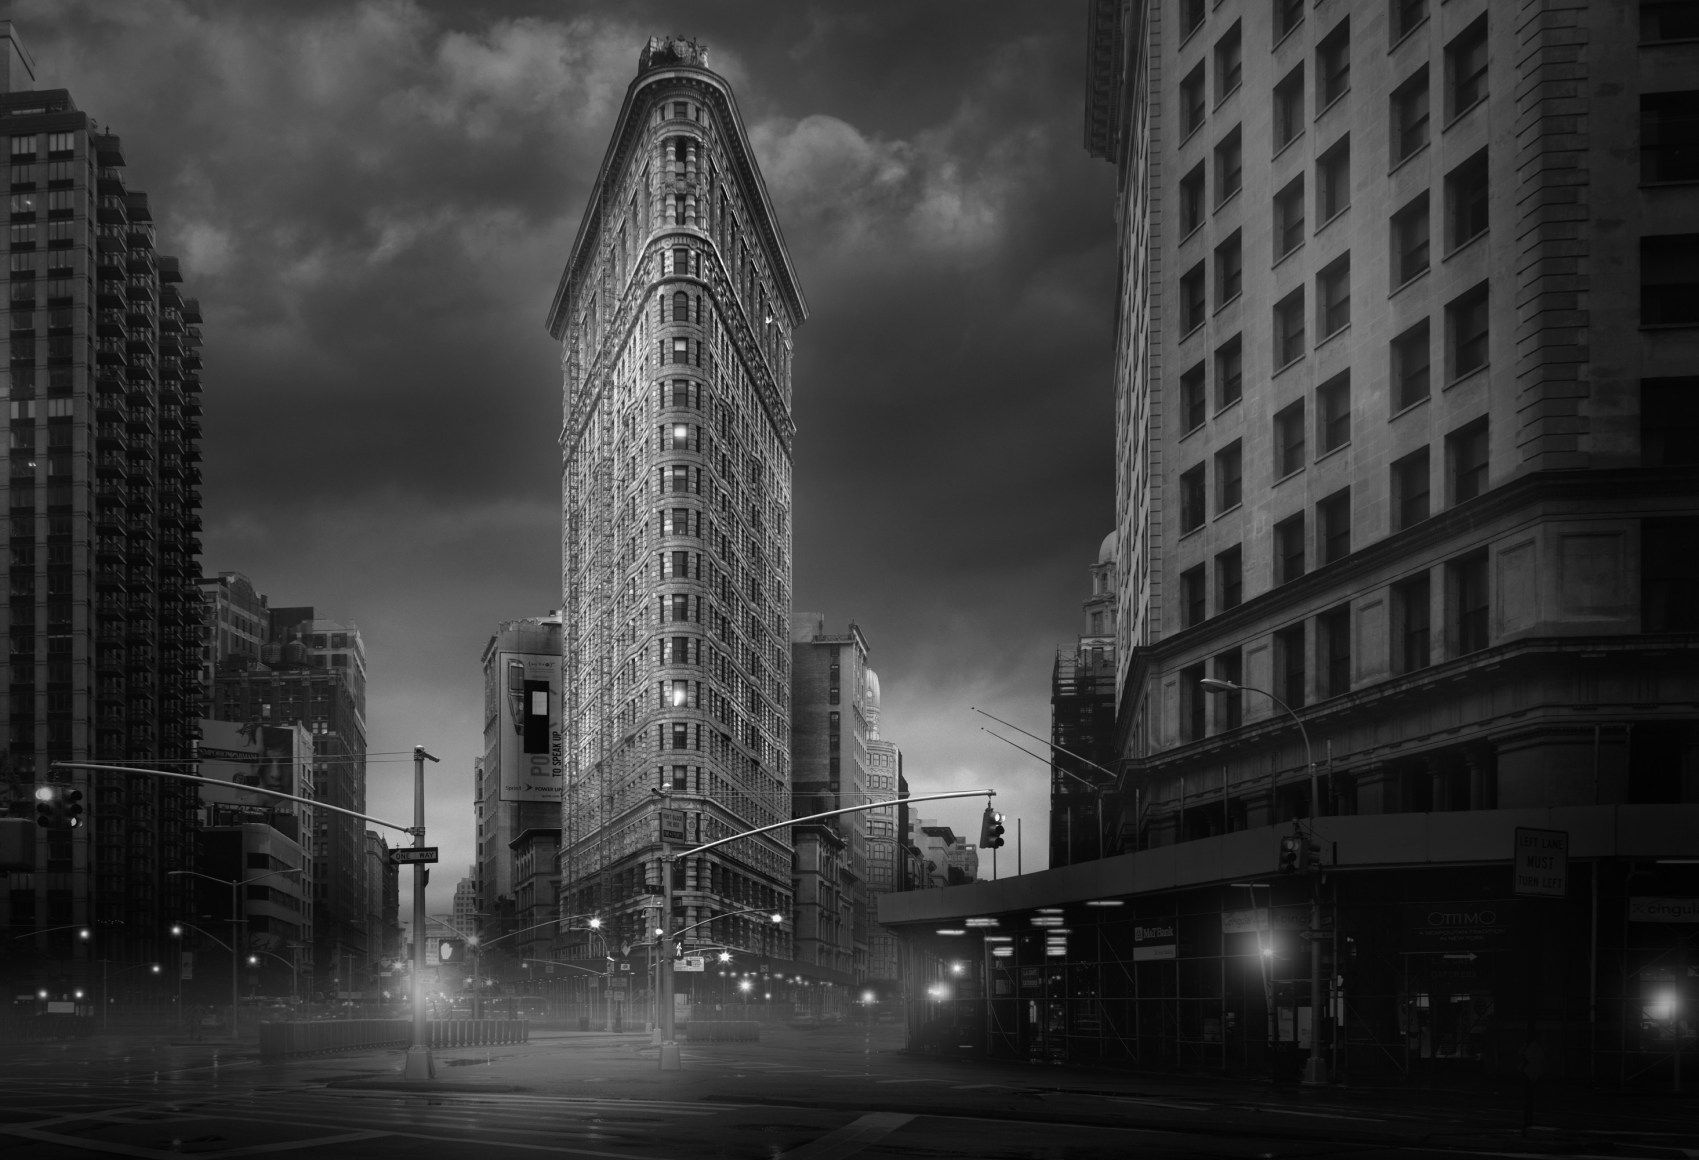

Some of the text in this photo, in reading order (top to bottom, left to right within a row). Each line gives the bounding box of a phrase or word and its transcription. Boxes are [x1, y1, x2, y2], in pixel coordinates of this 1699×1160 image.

[552, 731, 562, 778] TO SPEAK UP
[1519, 836, 1564, 850] LEFT LANE
[395, 851, 434, 860] ONE WAY
[1526, 855, 1555, 870] MUST
[1518, 874, 1563, 889] TURN LEFT
[1427, 910, 1497, 926] OTTIMO
[1156, 925, 1174, 938] Bank
